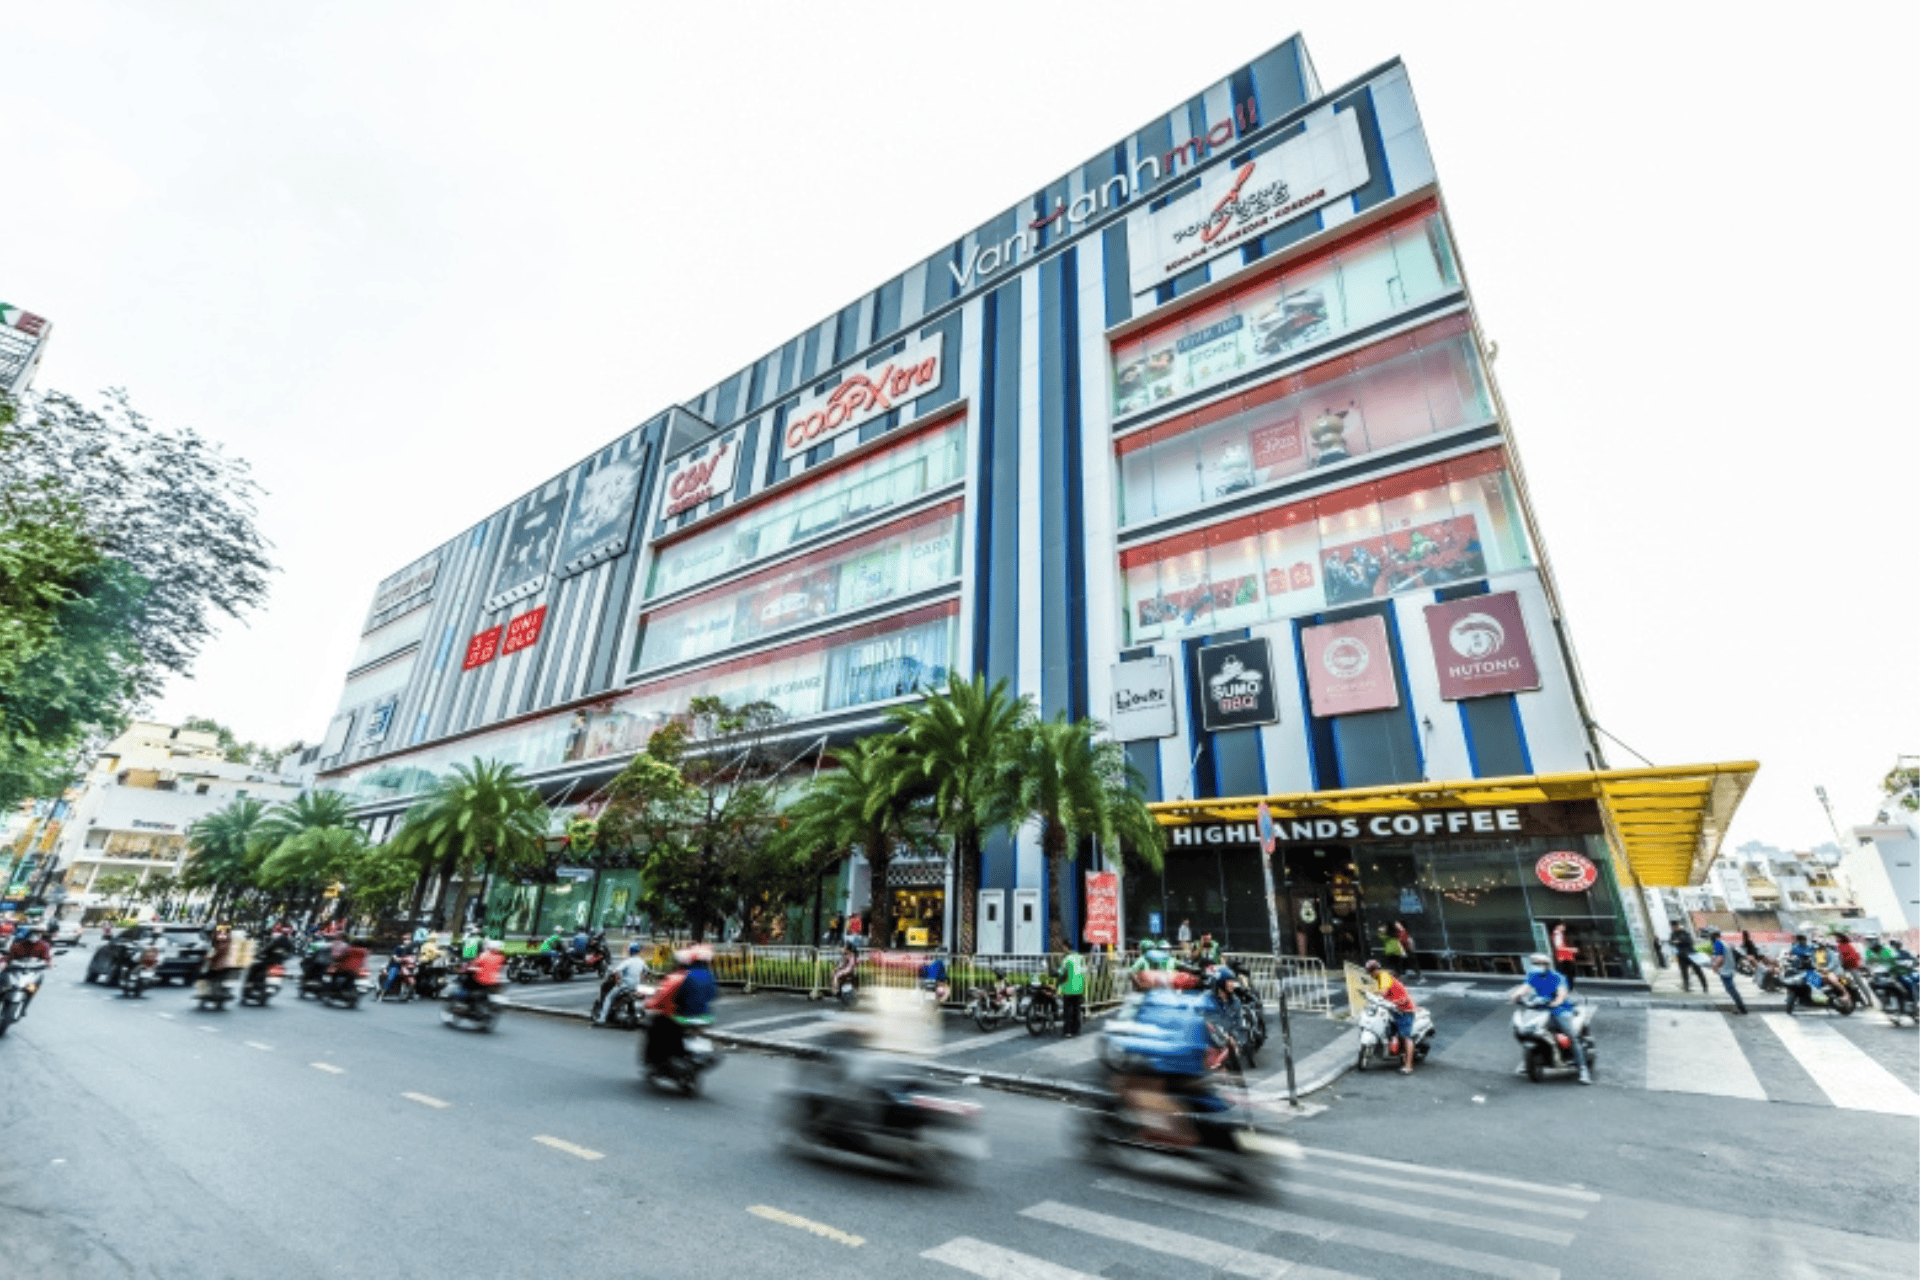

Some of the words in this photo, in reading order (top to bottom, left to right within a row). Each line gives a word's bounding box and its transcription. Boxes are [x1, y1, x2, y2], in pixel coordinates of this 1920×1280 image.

[1448, 656, 1521, 679] HUTONG
[1212, 681, 1260, 700] SUMO
[1219, 695, 1257, 712] BBQ
[1172, 817, 1360, 846] HIGHLANDS
[1369, 808, 1523, 837] COFFEE
